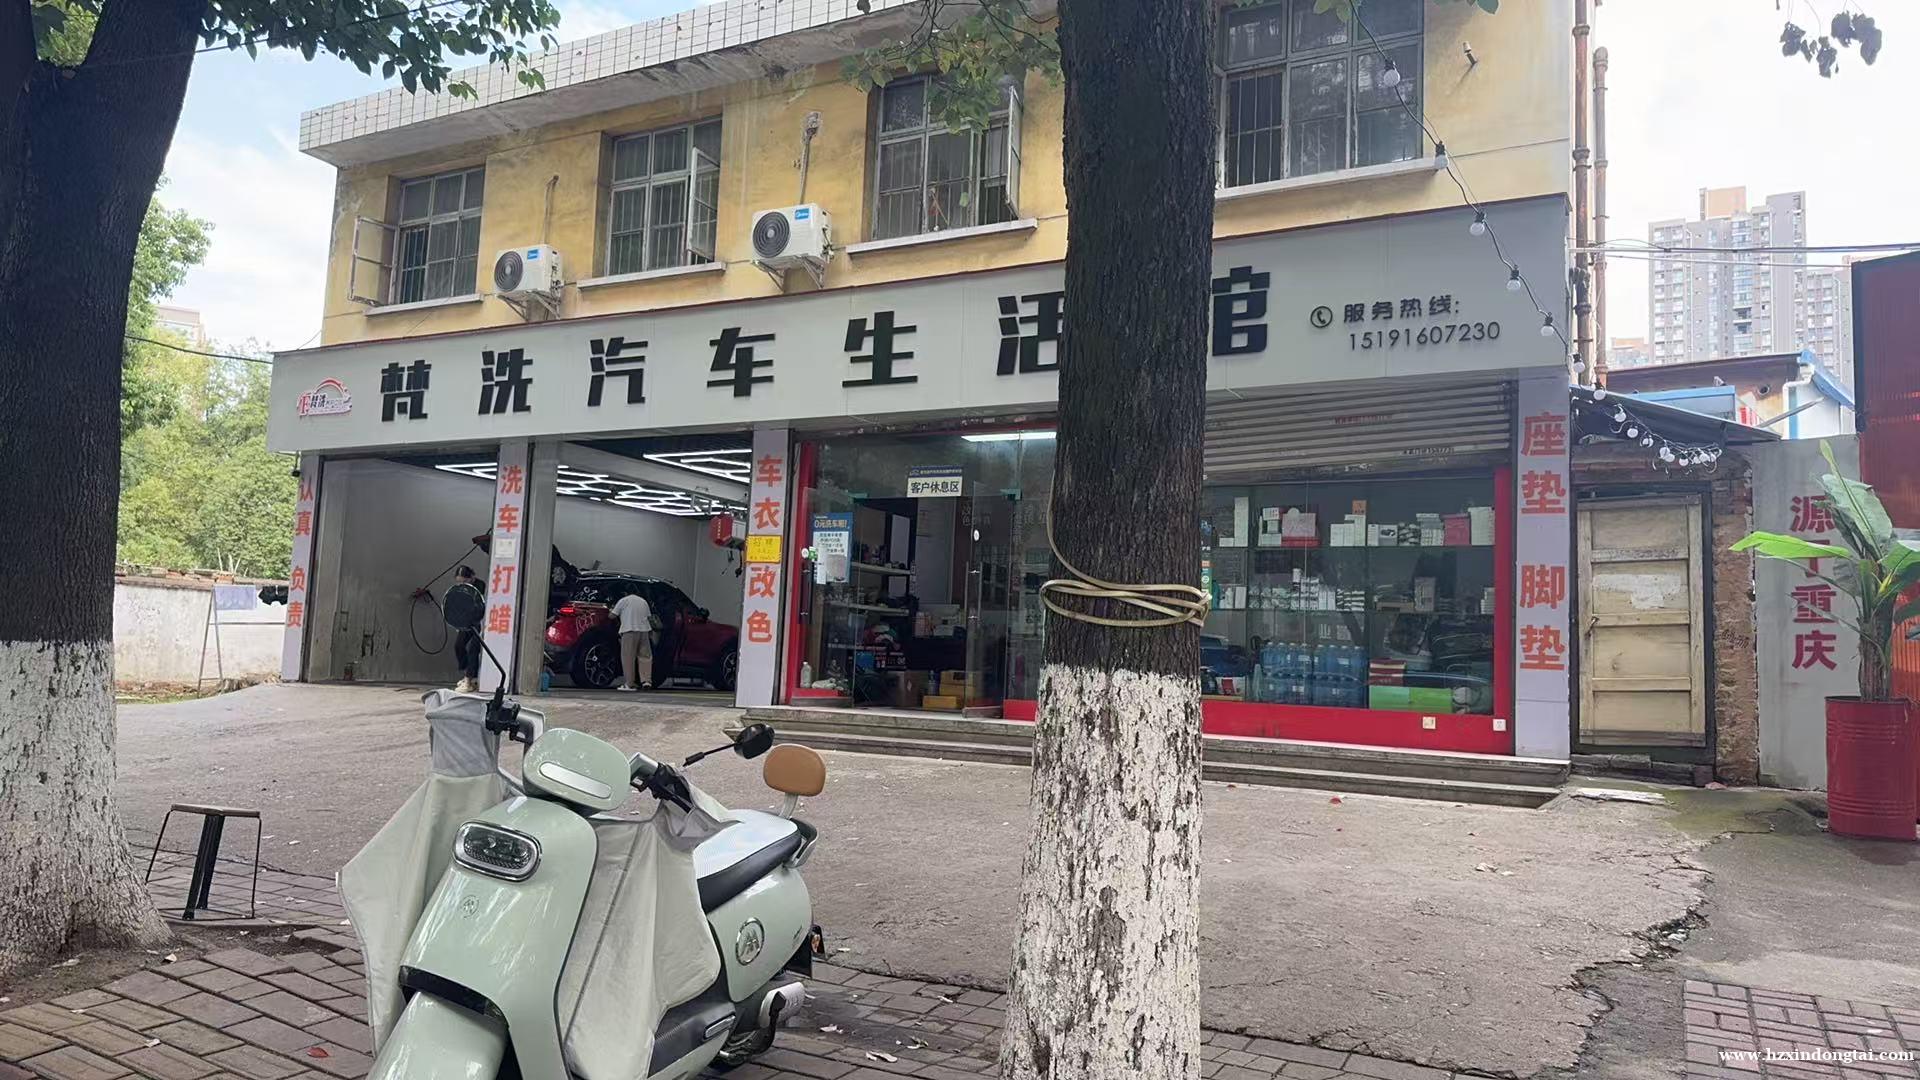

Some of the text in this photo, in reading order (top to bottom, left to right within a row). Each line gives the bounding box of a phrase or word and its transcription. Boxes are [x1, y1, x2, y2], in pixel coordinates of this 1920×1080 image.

[381, 265, 1270, 422] 梵洗汽车生活馆
[1349, 321, 1500, 351] 15191607230
[754, 454, 783, 530] 车衣
[911, 480, 960, 494] 客户休息区
[488, 464, 524, 635] 洗车 打蜡
[1520, 411, 1566, 671] 座垫 脚垫
[747, 566, 777, 644] 改色
